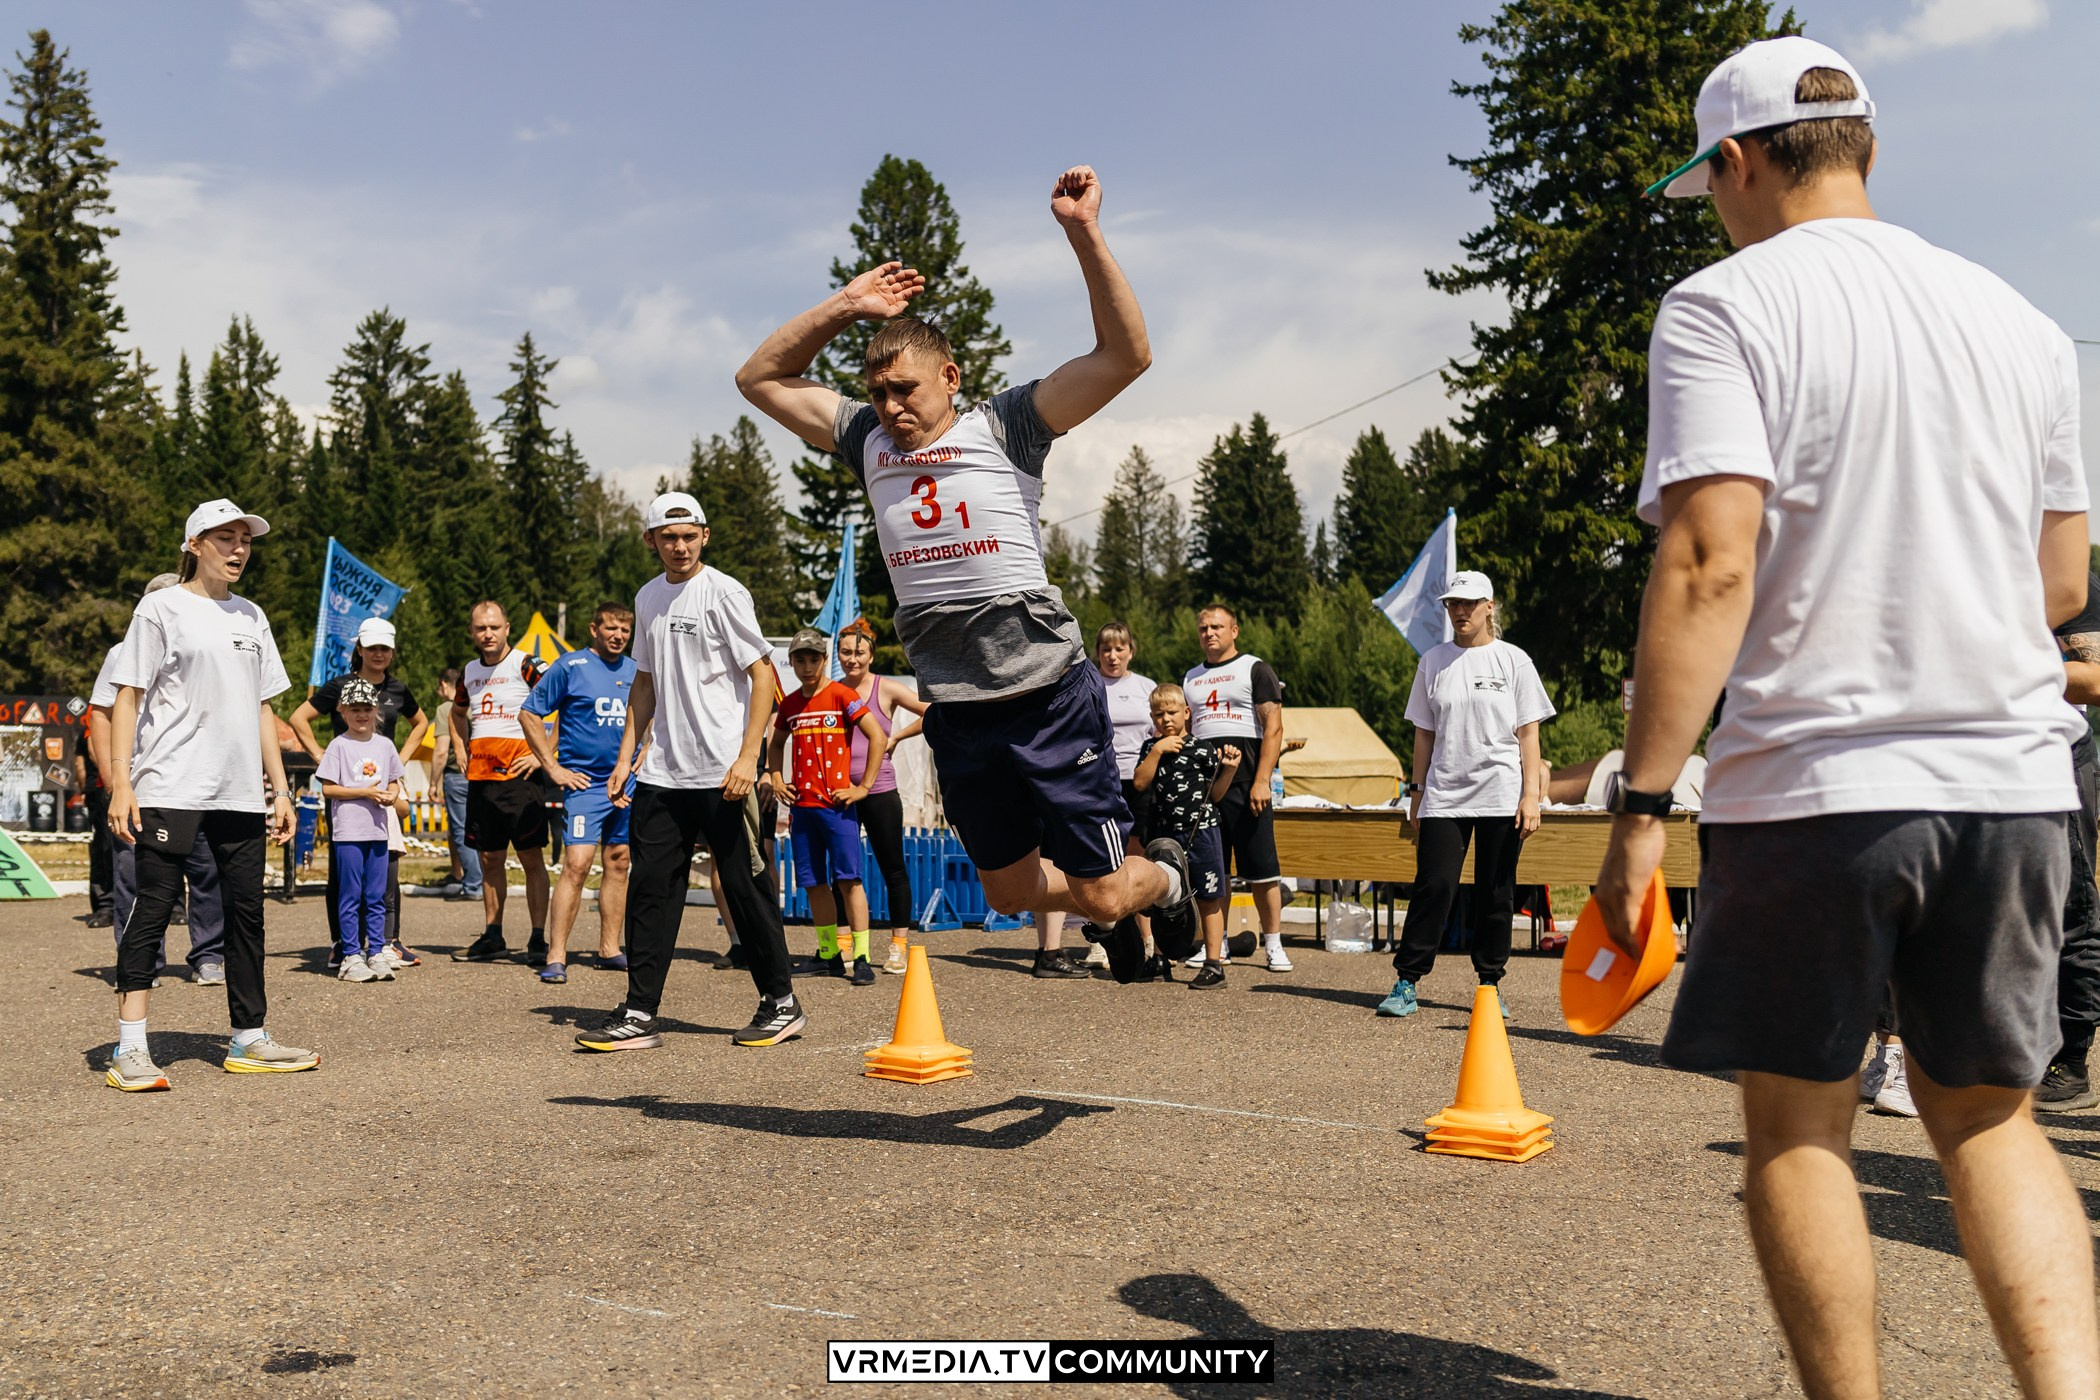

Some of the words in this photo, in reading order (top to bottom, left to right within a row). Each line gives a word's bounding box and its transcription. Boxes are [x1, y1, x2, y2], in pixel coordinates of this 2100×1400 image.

[911, 475, 942, 529] 3
[955, 501, 970, 529] 1
[331, 573, 375, 611] ОССИИ
[482, 692, 493, 715] 6
[595, 697, 626, 717] СД
[1205, 689, 1219, 712] 4
[1224, 701, 1231, 717] 1
[597, 717, 625, 727] УГО
[1077, 754, 1098, 765] adidas
